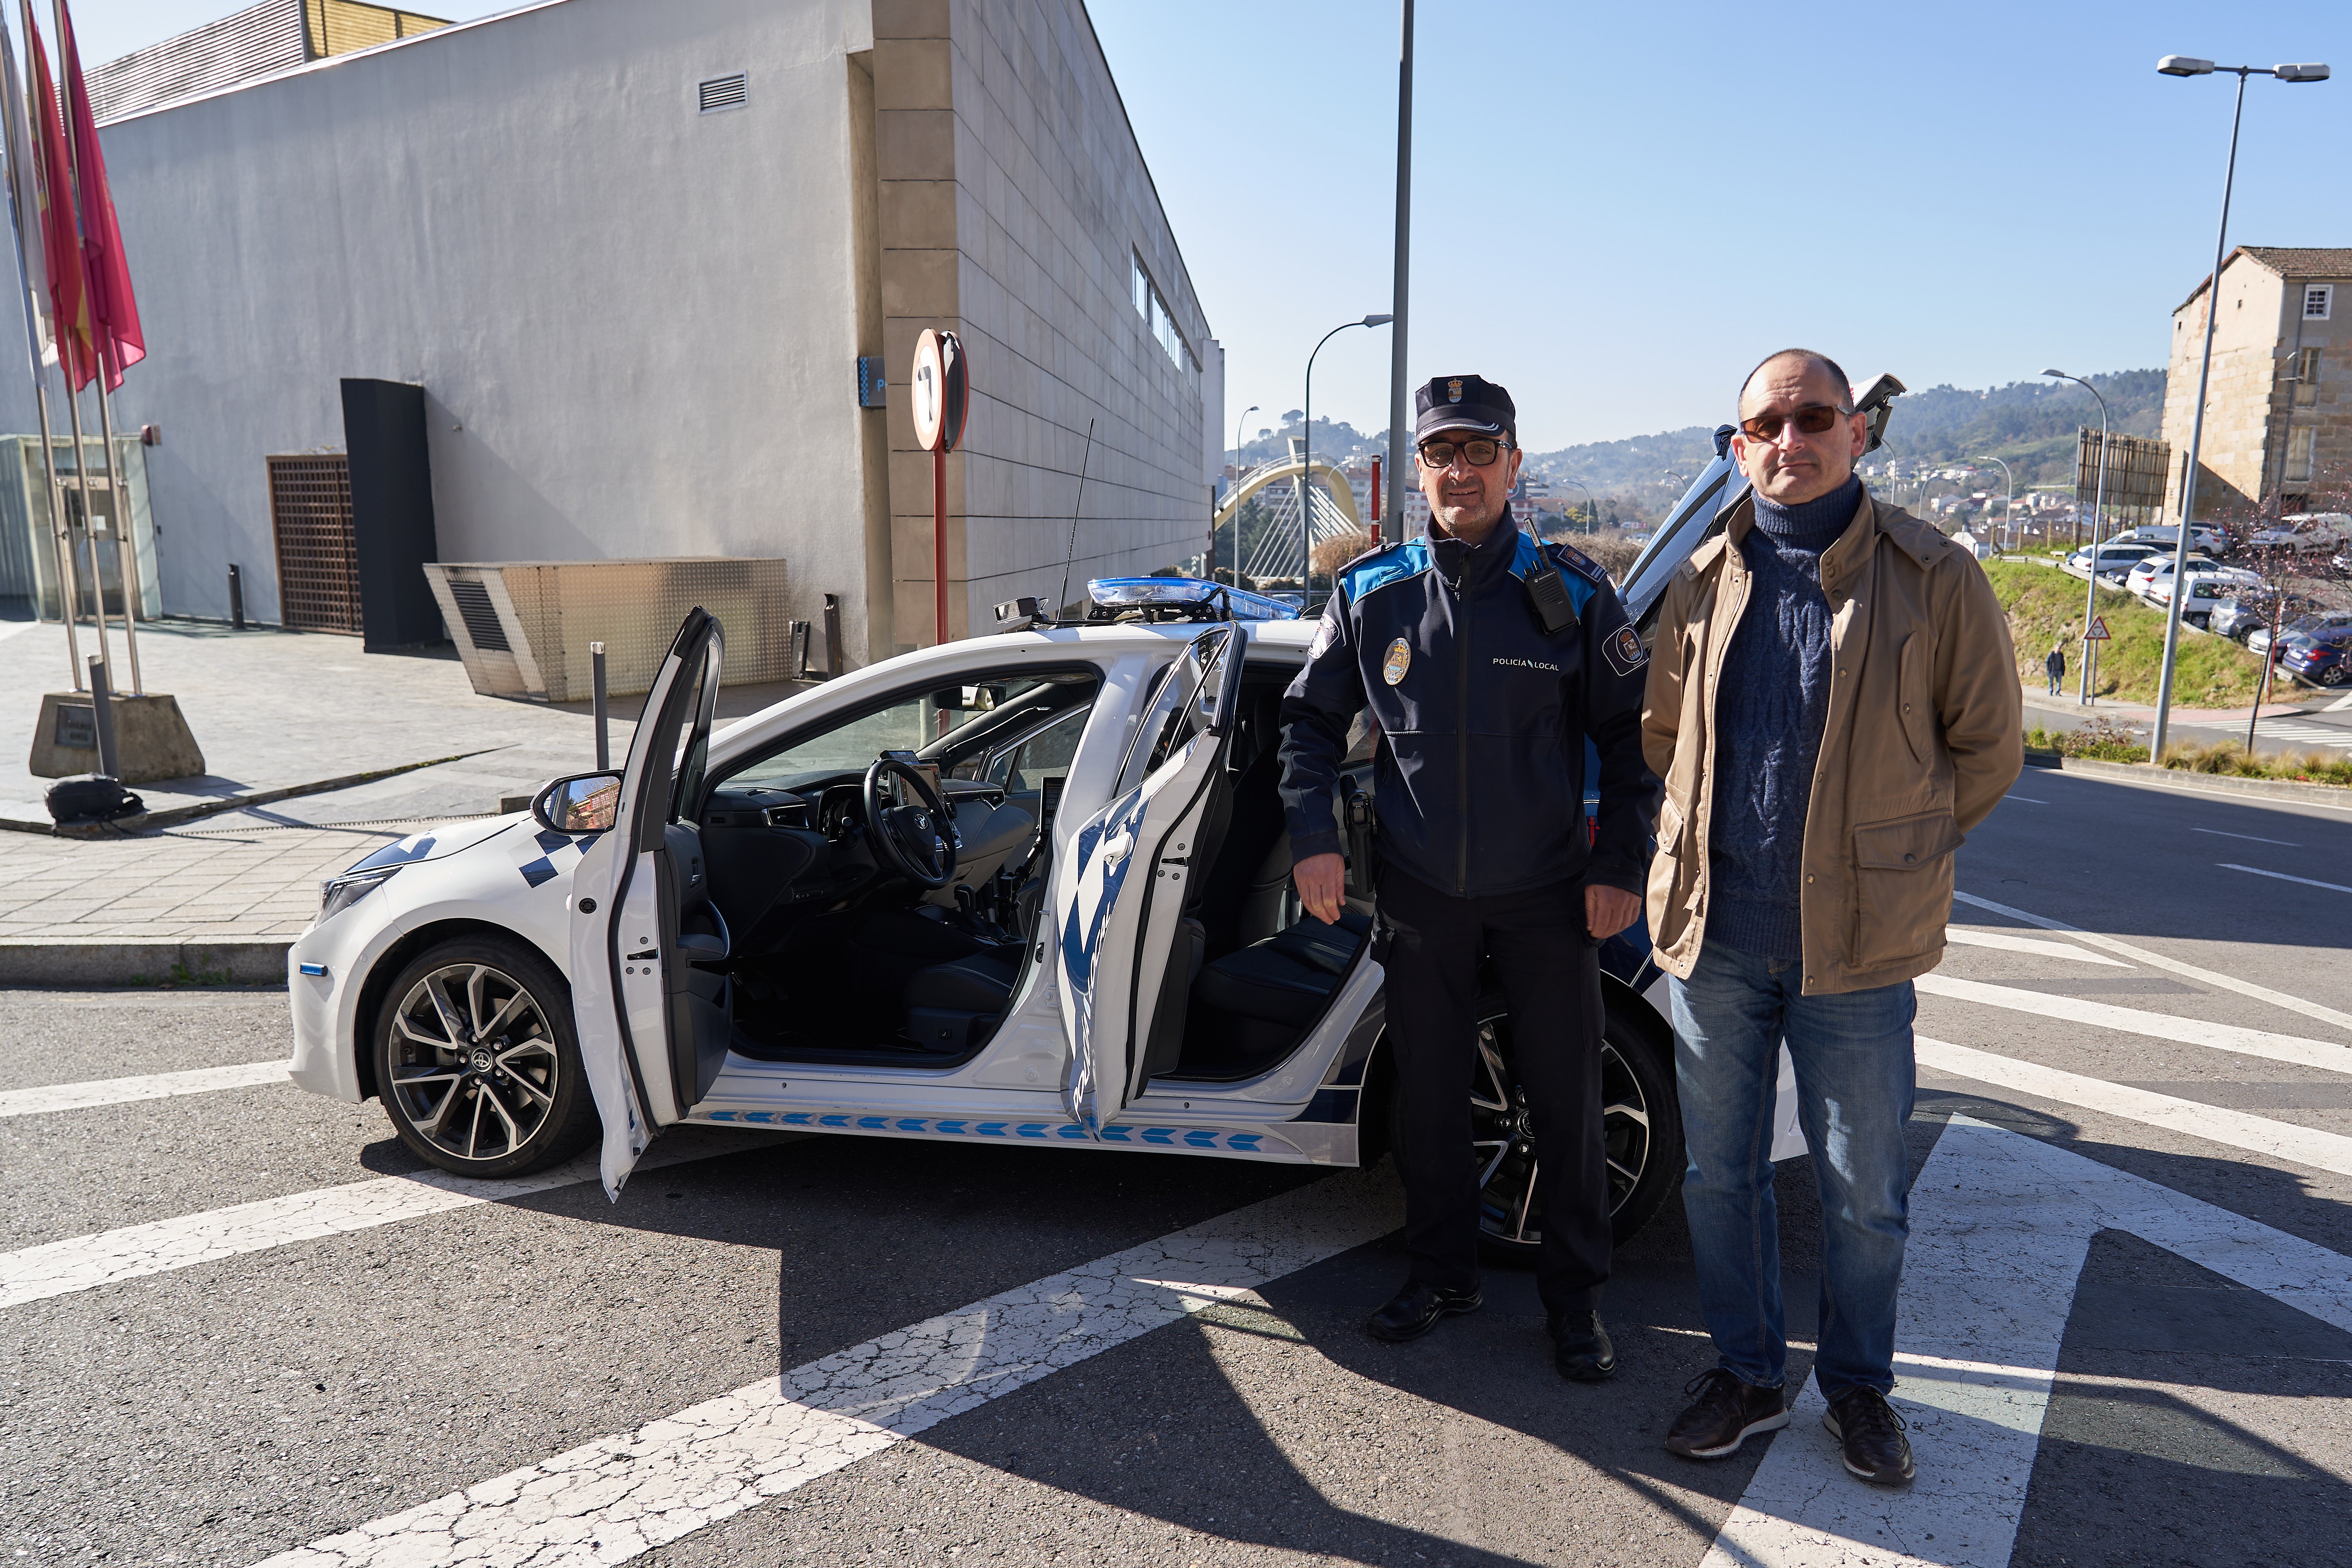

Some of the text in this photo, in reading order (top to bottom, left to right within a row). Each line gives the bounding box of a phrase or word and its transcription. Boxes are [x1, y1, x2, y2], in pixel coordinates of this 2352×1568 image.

[878, 379, 887, 391] P
[1539, 571, 1555, 580] MOTOROLA
[1493, 658, 1559, 671] POLICÍA LOCAL
[1087, 901, 1111, 1004] LOCAL
